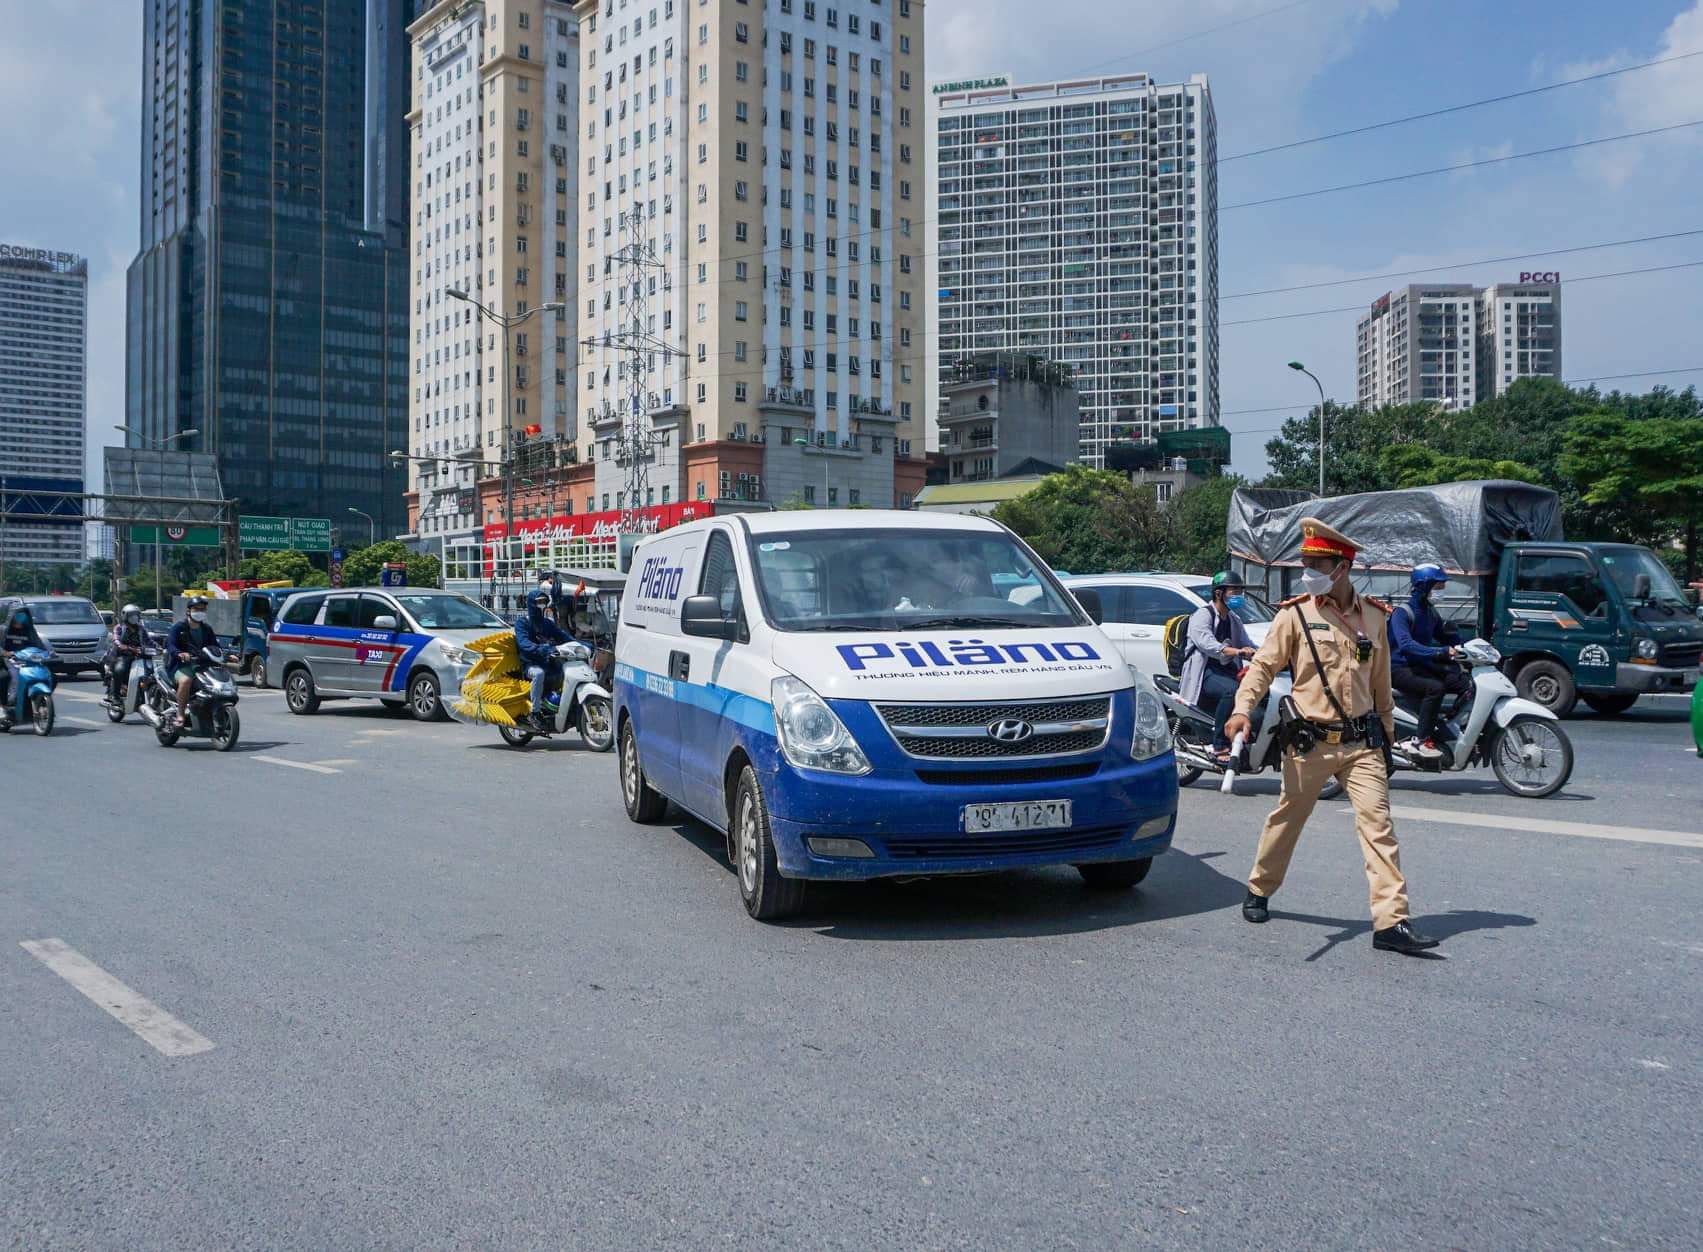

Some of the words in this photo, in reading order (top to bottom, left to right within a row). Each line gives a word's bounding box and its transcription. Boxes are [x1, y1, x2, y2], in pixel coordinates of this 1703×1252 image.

[974, 76, 1009, 89] PLAZA
[1519, 271, 1560, 284] PCC1
[368, 649, 383, 659] TAXI
